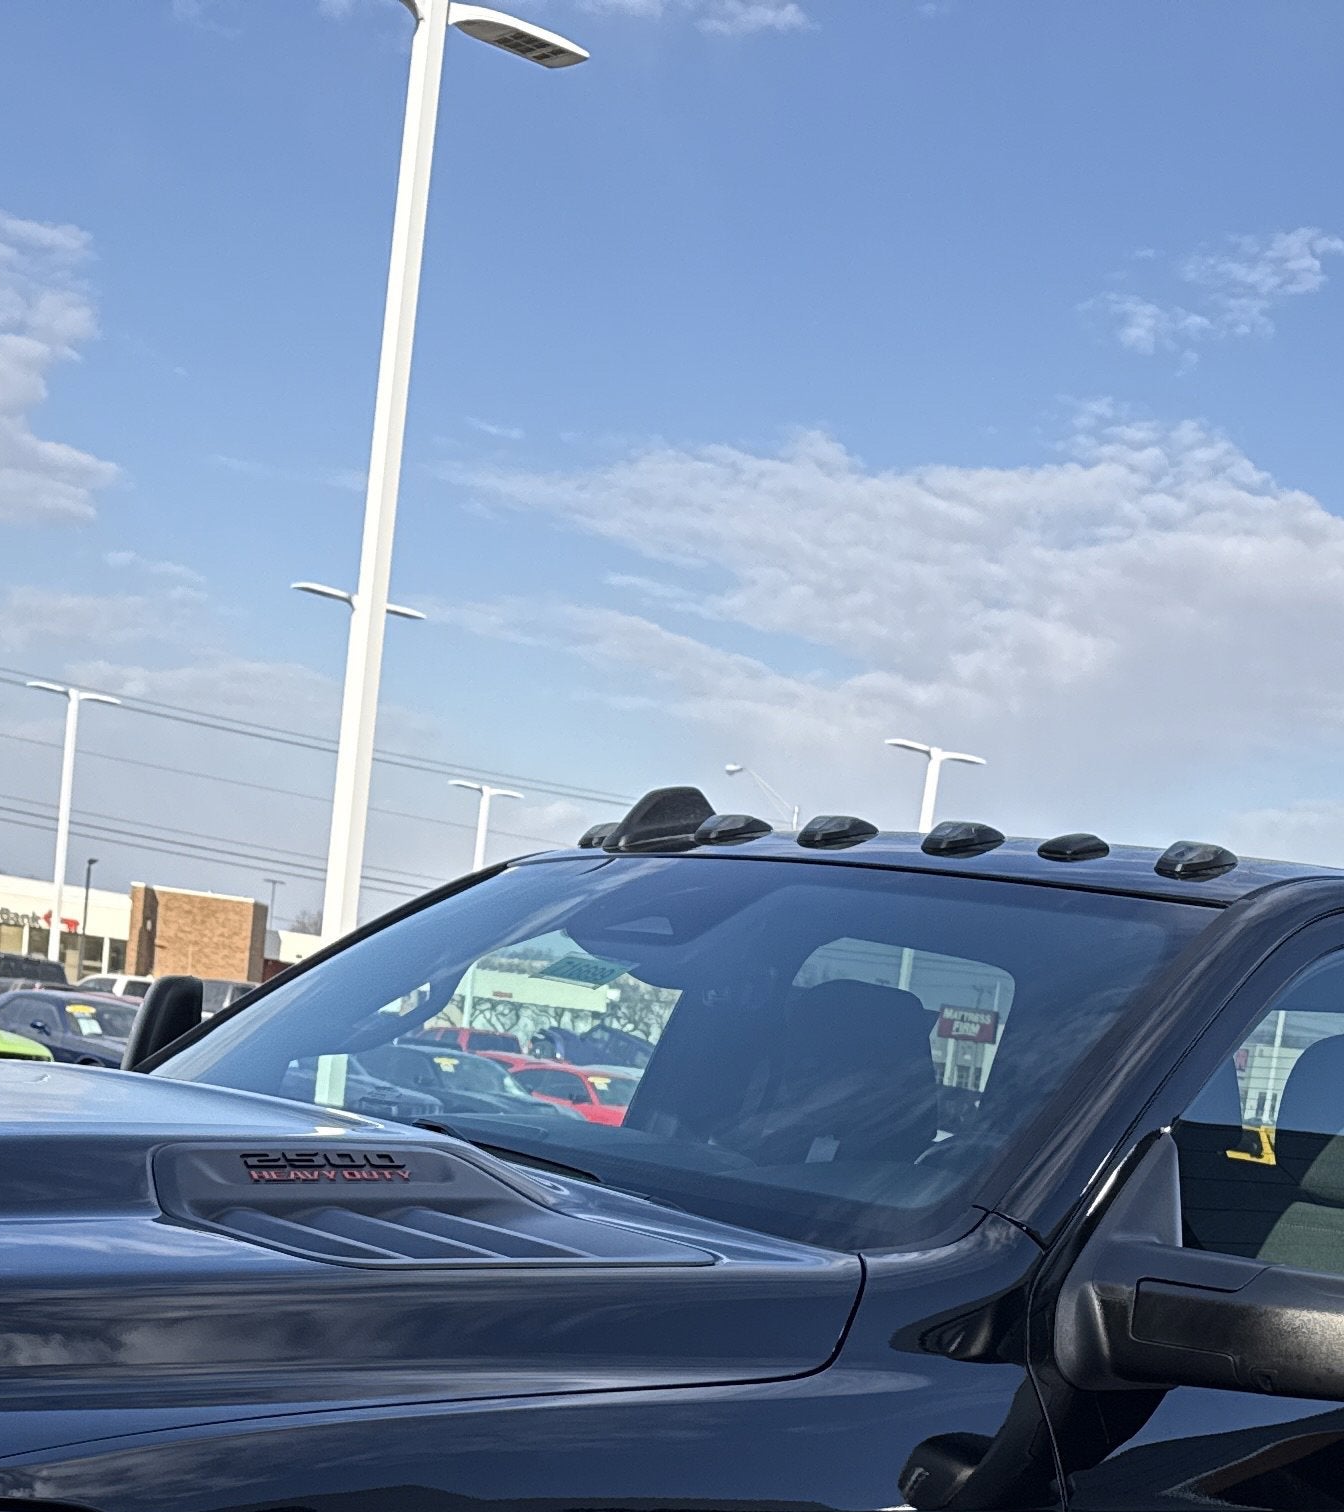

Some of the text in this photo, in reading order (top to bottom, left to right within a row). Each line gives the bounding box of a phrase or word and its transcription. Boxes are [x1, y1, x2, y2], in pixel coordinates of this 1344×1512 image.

[239, 1151, 406, 1170] 2500
[249, 1169, 412, 1183] HEAVY DUTY
